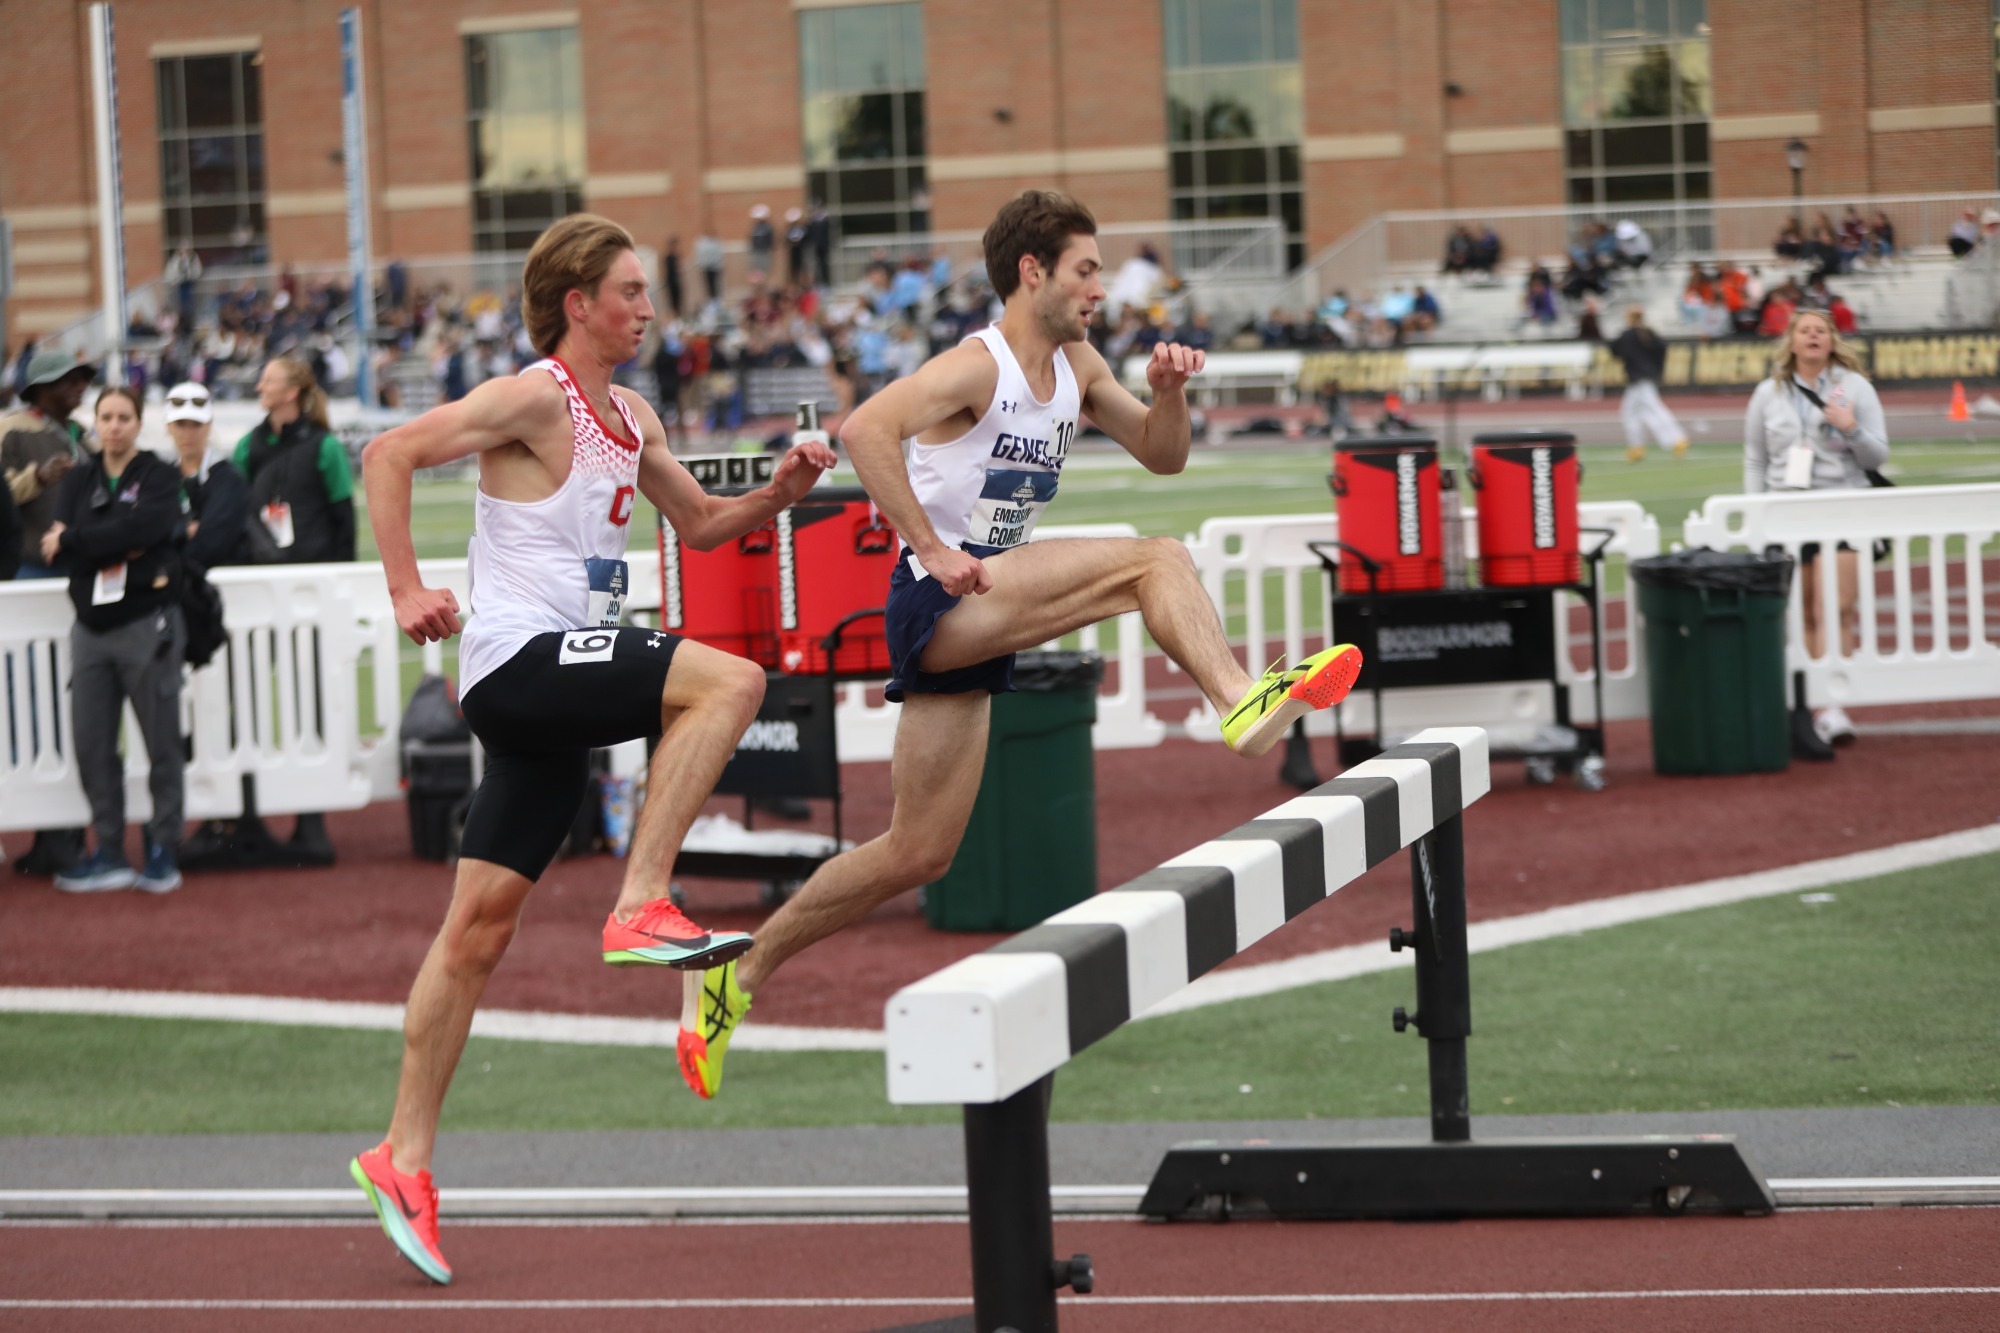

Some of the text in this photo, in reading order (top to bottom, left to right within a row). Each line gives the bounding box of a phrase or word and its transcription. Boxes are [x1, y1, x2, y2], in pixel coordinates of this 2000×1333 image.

[1057, 421, 1074, 456] 10
[609, 484, 635, 527] C
[1398, 454, 1420, 554] BODYARMOR
[1532, 447, 1554, 549] BODYARMOR
